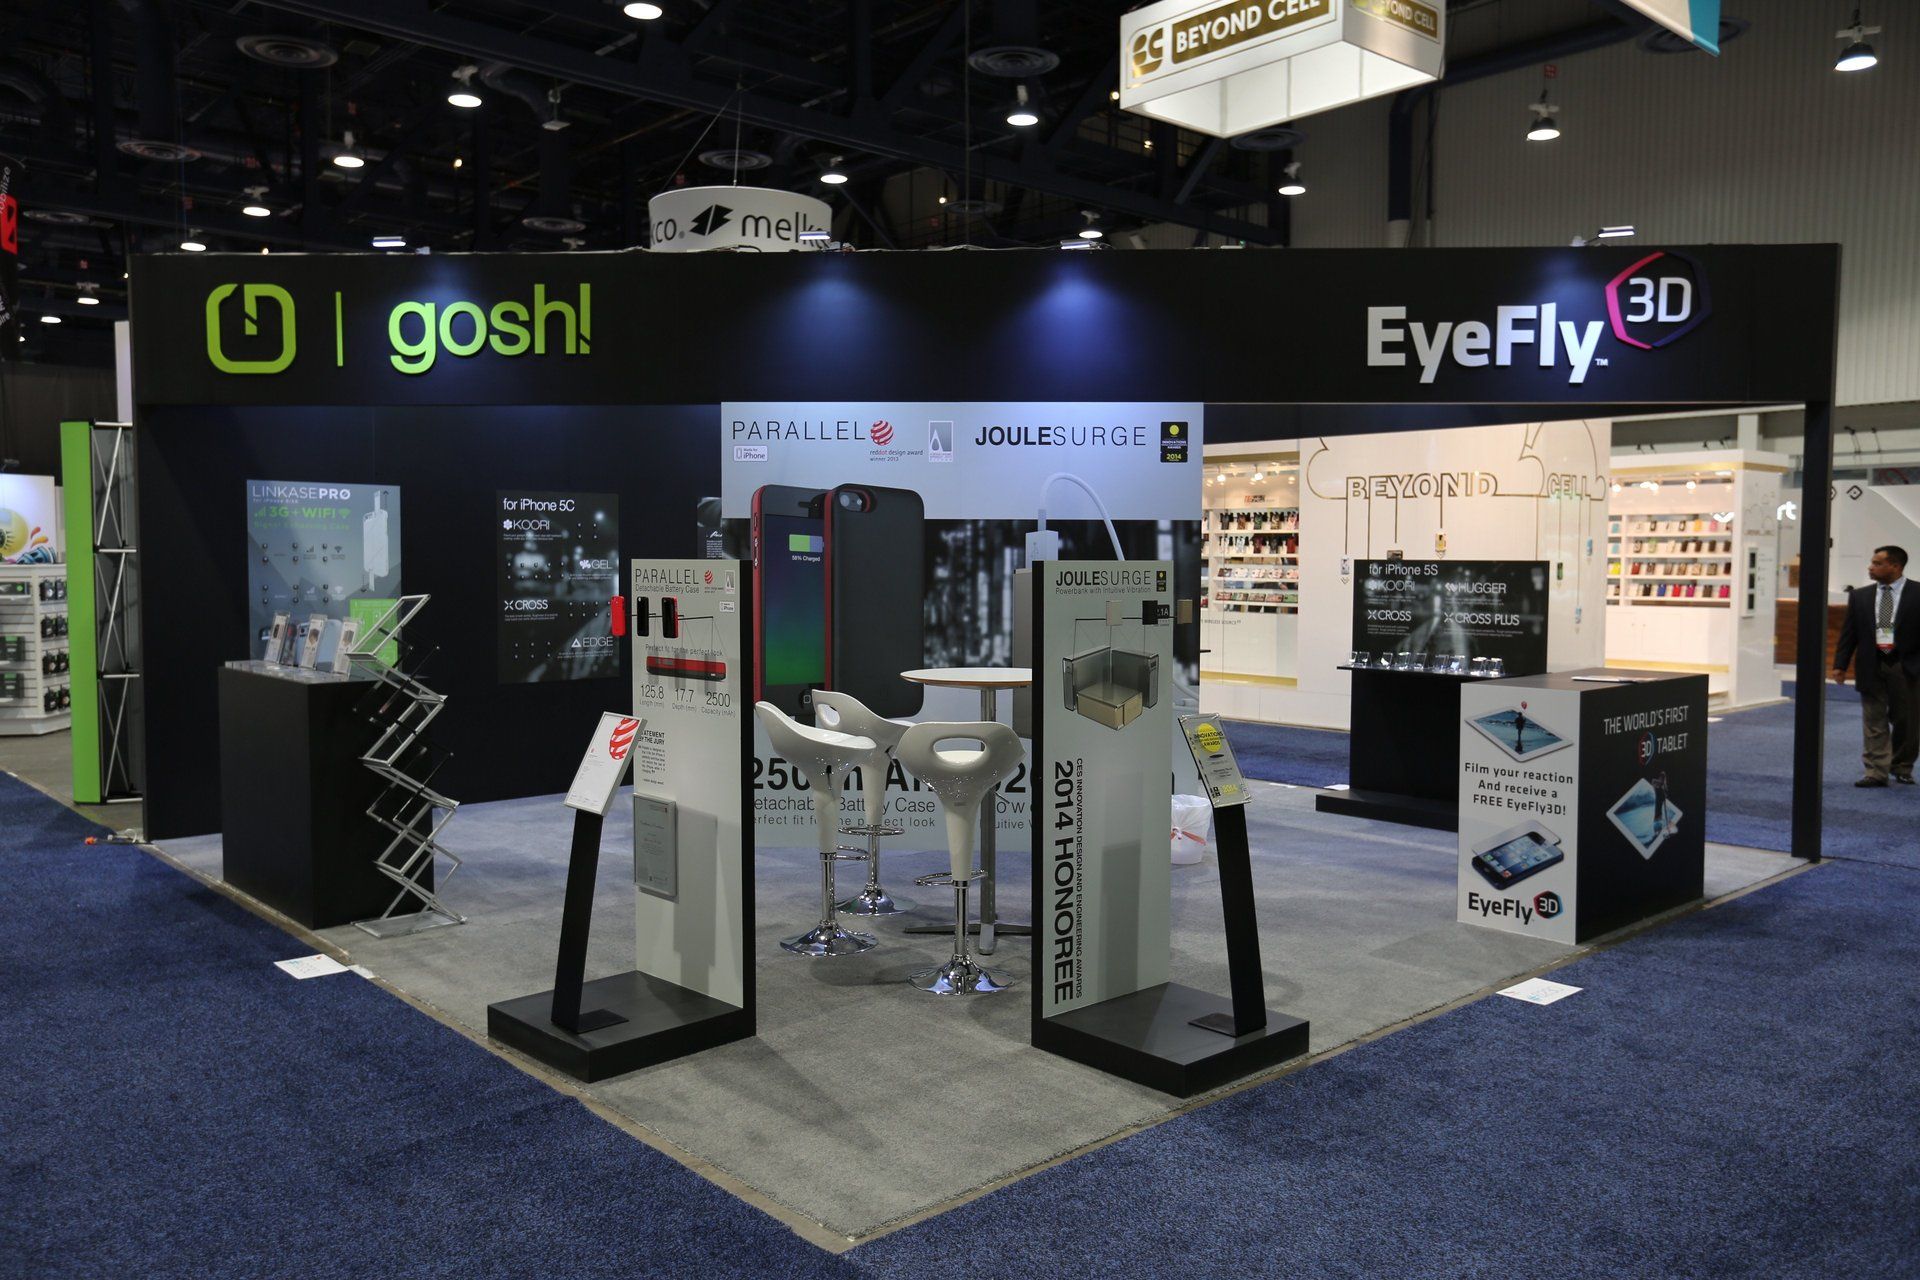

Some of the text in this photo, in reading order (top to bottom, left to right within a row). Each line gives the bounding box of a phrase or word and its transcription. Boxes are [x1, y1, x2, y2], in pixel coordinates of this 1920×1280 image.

[1413, 10, 1435, 31] CELL
[1175, 6, 1262, 54] BEYOND
[741, 211, 830, 249] melk
[1626, 276, 1692, 324] 3D
[388, 282, 591, 374] gosh!
[1367, 302, 1605, 384] EyeFly
[732, 420, 867, 441] PARALLEL
[975, 426, 1147, 446] JOULESURGE
[889, 449, 906, 457] design
[1346, 472, 1592, 500] BEYOND CELL
[269, 506, 289, 518] 3G
[302, 507, 336, 519] WIFI
[503, 498, 575, 512] for iPhone 5C
[513, 519, 550, 531] KOORI
[591, 559, 613, 570] GEL
[1369, 563, 1439, 576] for iPhone 5S
[635, 568, 700, 585] PARALLEL
[1056, 571, 1151, 586] JOULESURGE
[665, 585, 684, 595] Battery
[685, 585, 700, 594] Case
[1055, 587, 1088, 595] Powerbank
[1458, 582, 1507, 594] HUGGER
[1494, 614, 1520, 626] PLUS
[582, 637, 614, 647] EDGE
[640, 685, 664, 699] 125.8
[675, 688, 694, 703] 17.7
[706, 691, 731, 708] 2500
[1603, 705, 1689, 735] THE WORLD'S FIRST
[1640, 732, 1688, 756] 3D TABLET
[1464, 762, 1573, 784] Film your reaction
[1055, 760, 1074, 830] 2014
[1478, 779, 1558, 799] And receive a
[895, 797, 935, 813] Case
[1473, 794, 1567, 816] FREE EyeFly3D!
[792, 814, 805, 826] fit
[909, 815, 935, 827] look
[1468, 891, 1559, 925] EyeFly 3D
[1055, 838, 1074, 1005] HONOREE
[1075, 958, 1083, 998] AWARDS
